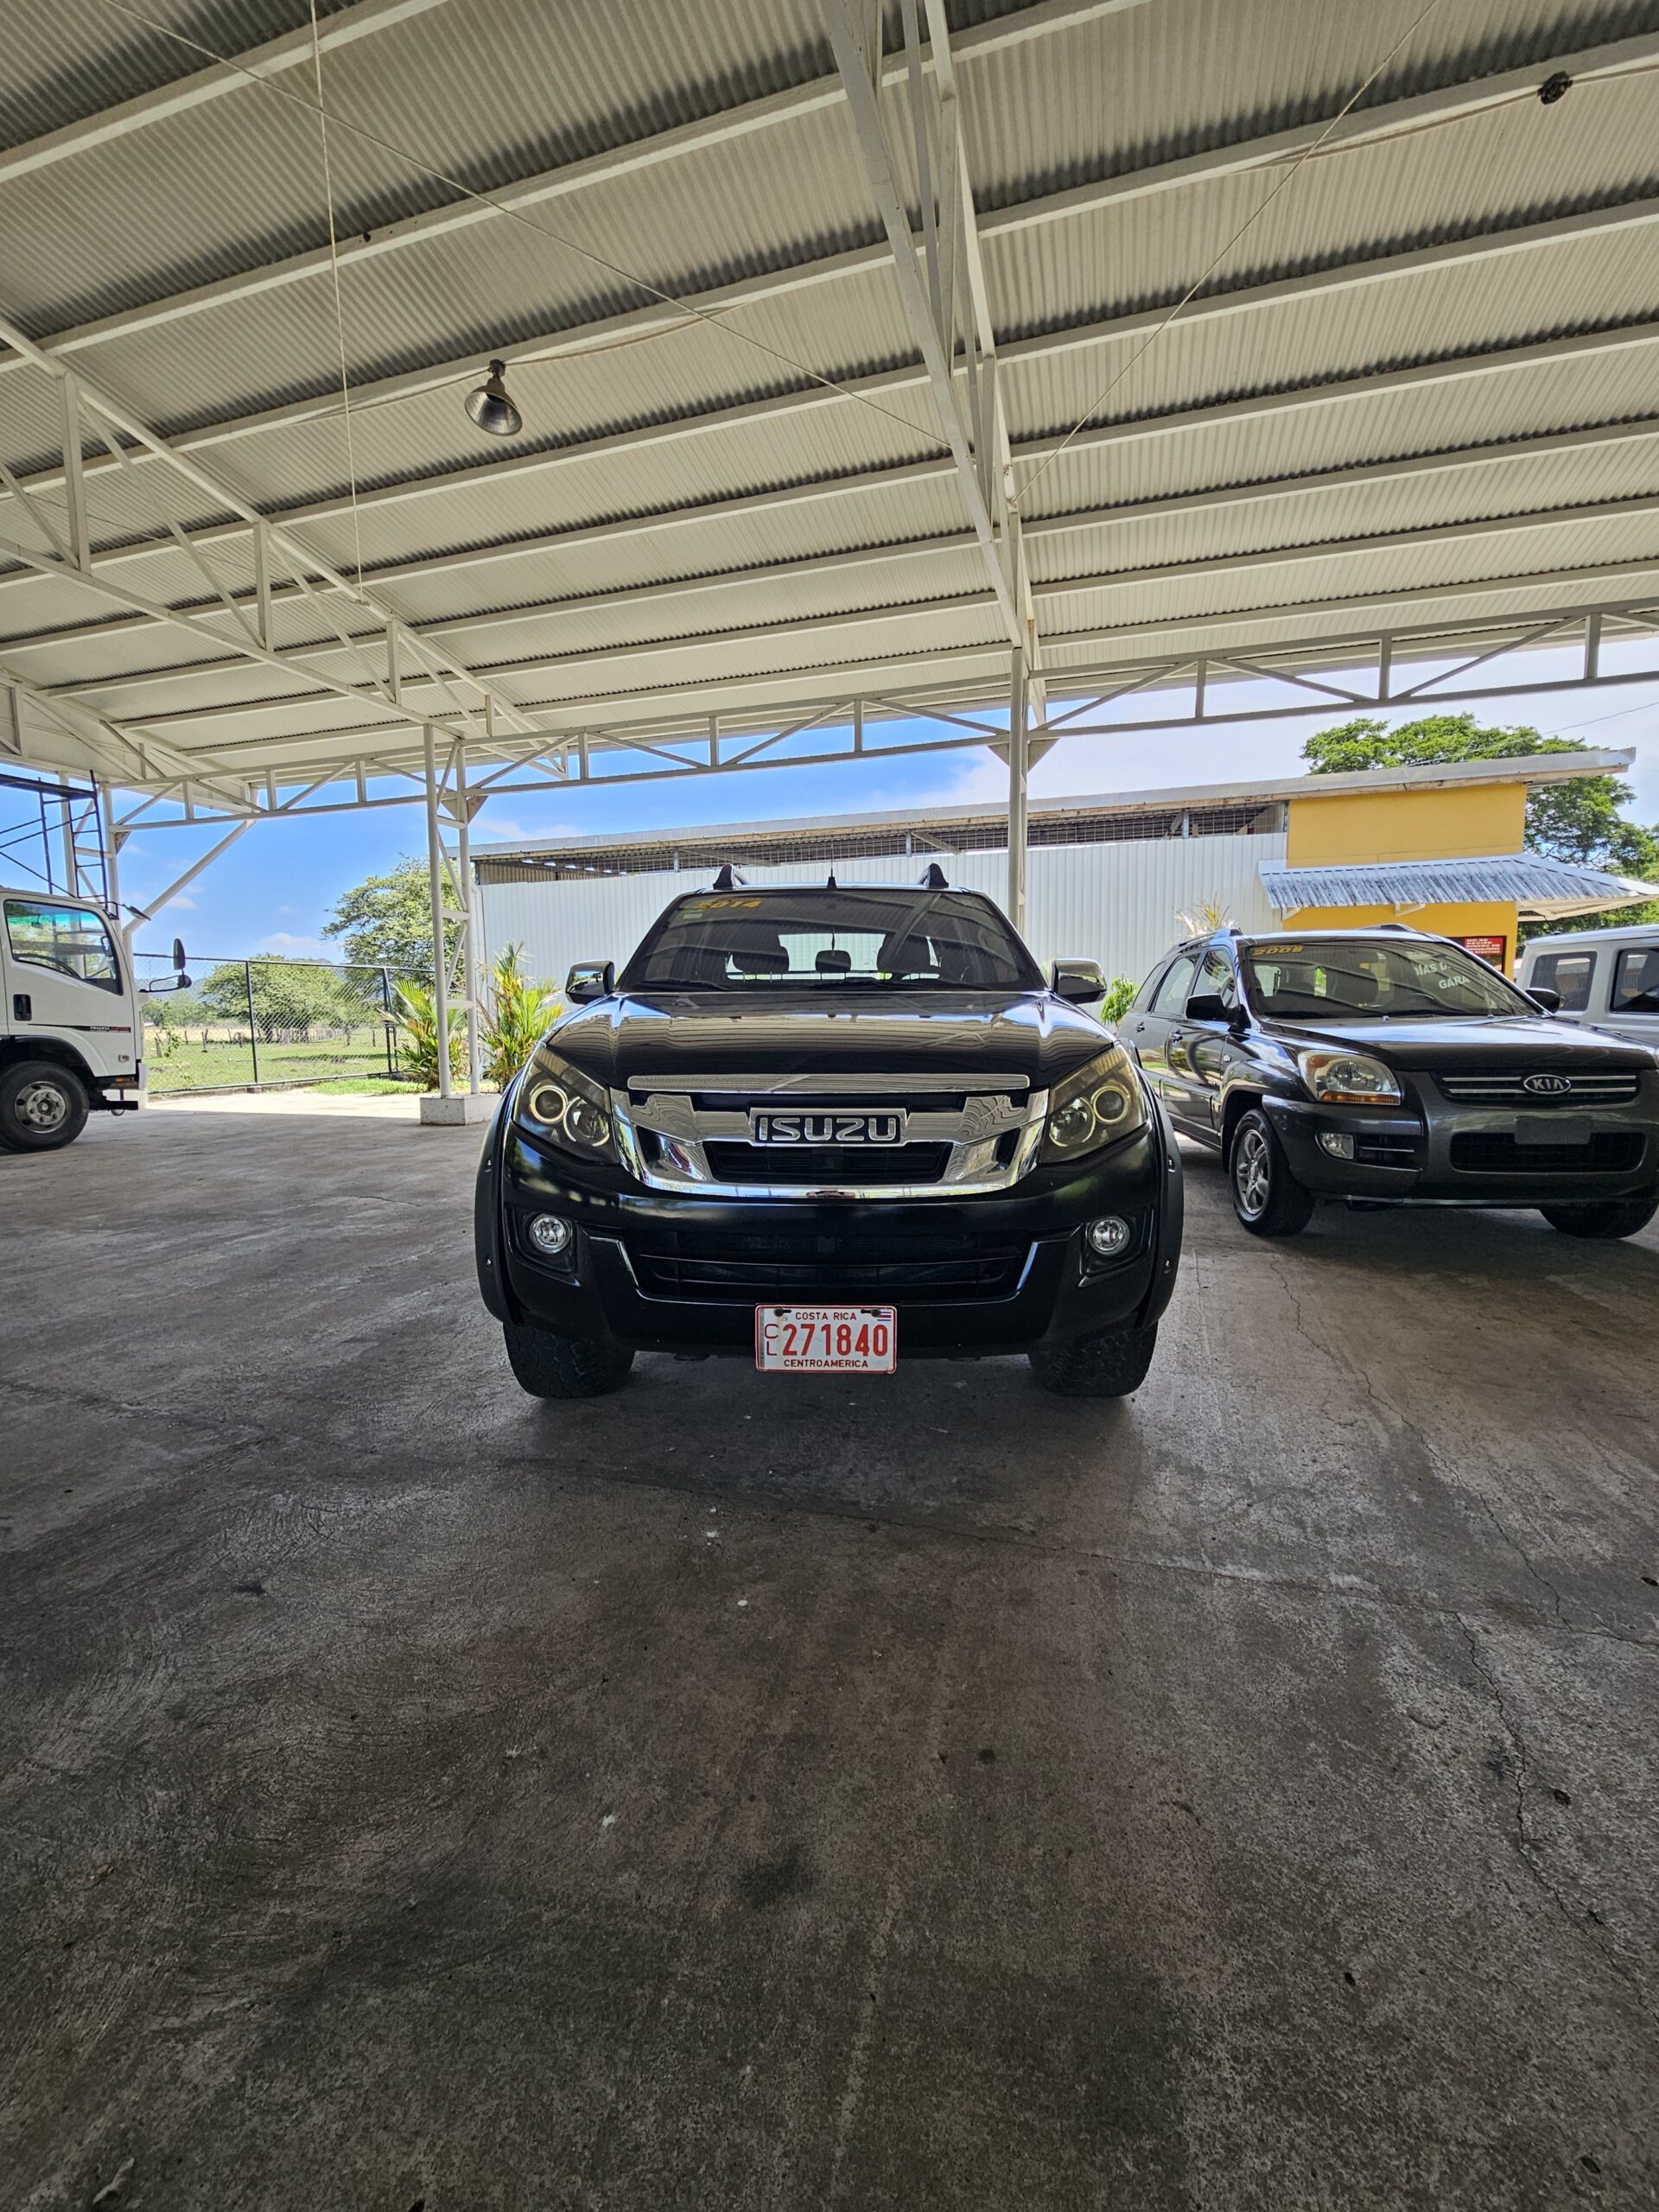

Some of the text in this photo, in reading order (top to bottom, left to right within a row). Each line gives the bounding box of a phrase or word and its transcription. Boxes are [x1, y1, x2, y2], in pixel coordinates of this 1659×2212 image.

[1532, 1078, 1564, 1090] KIA
[759, 1117, 896, 1141] ISUZU
[795, 1312, 828, 1320] COSTA
[833, 1312, 856, 1320] RICA
[783, 1324, 888, 1357] 271840
[784, 1359, 868, 1368] CENTROAMERICA
